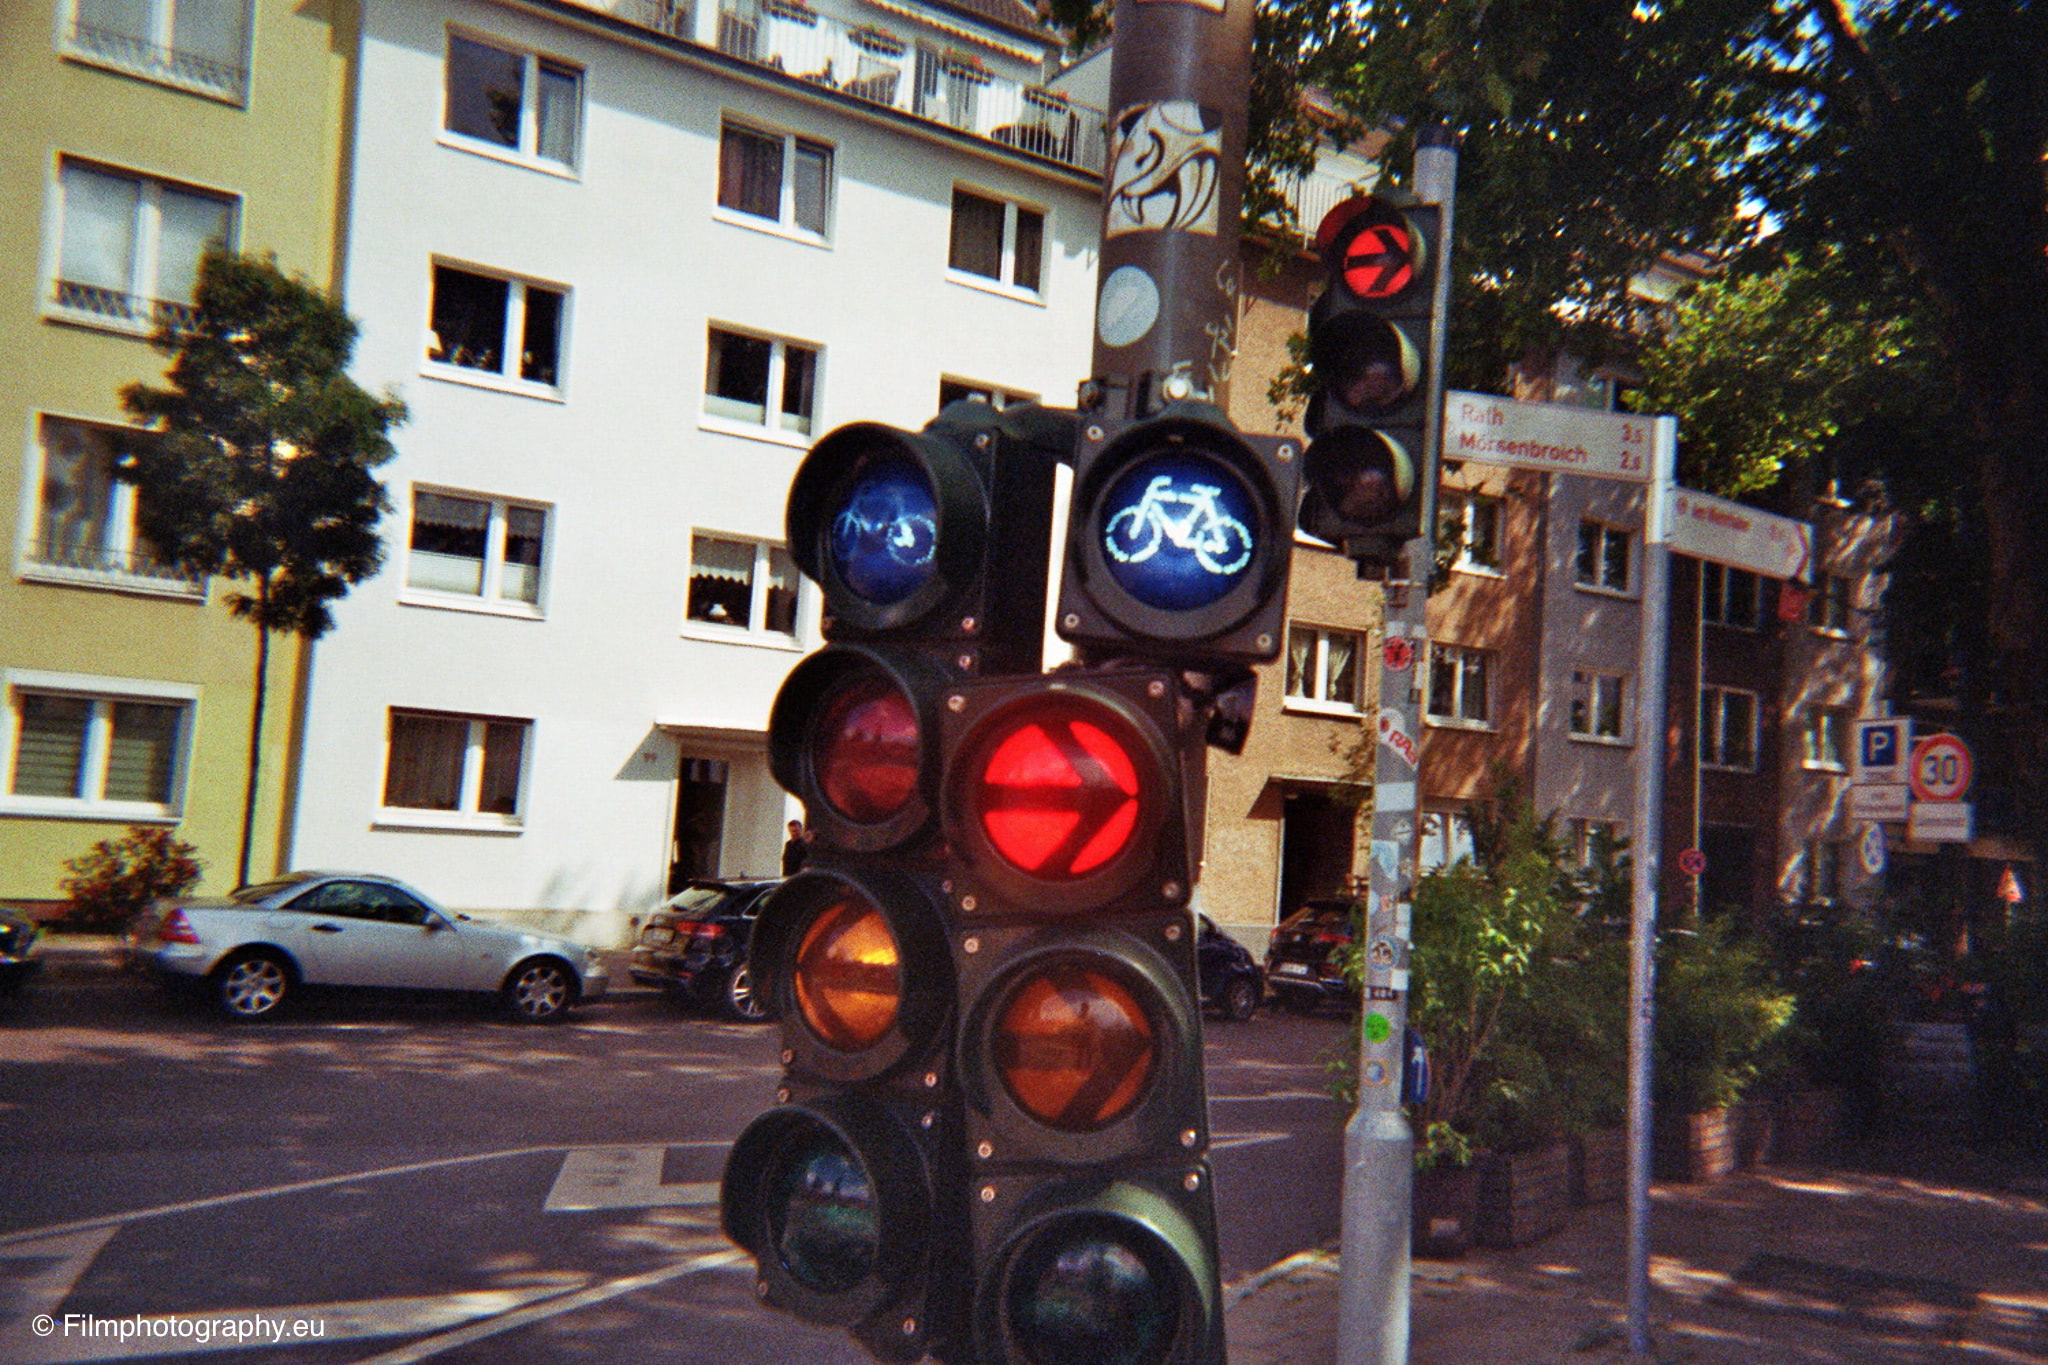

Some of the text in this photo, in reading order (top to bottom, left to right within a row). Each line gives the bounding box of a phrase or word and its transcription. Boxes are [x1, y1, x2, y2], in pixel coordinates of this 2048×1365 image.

[1462, 403, 1504, 426] Rath
[1868, 731, 1890, 762] P
[1922, 754, 1958, 785] 30
